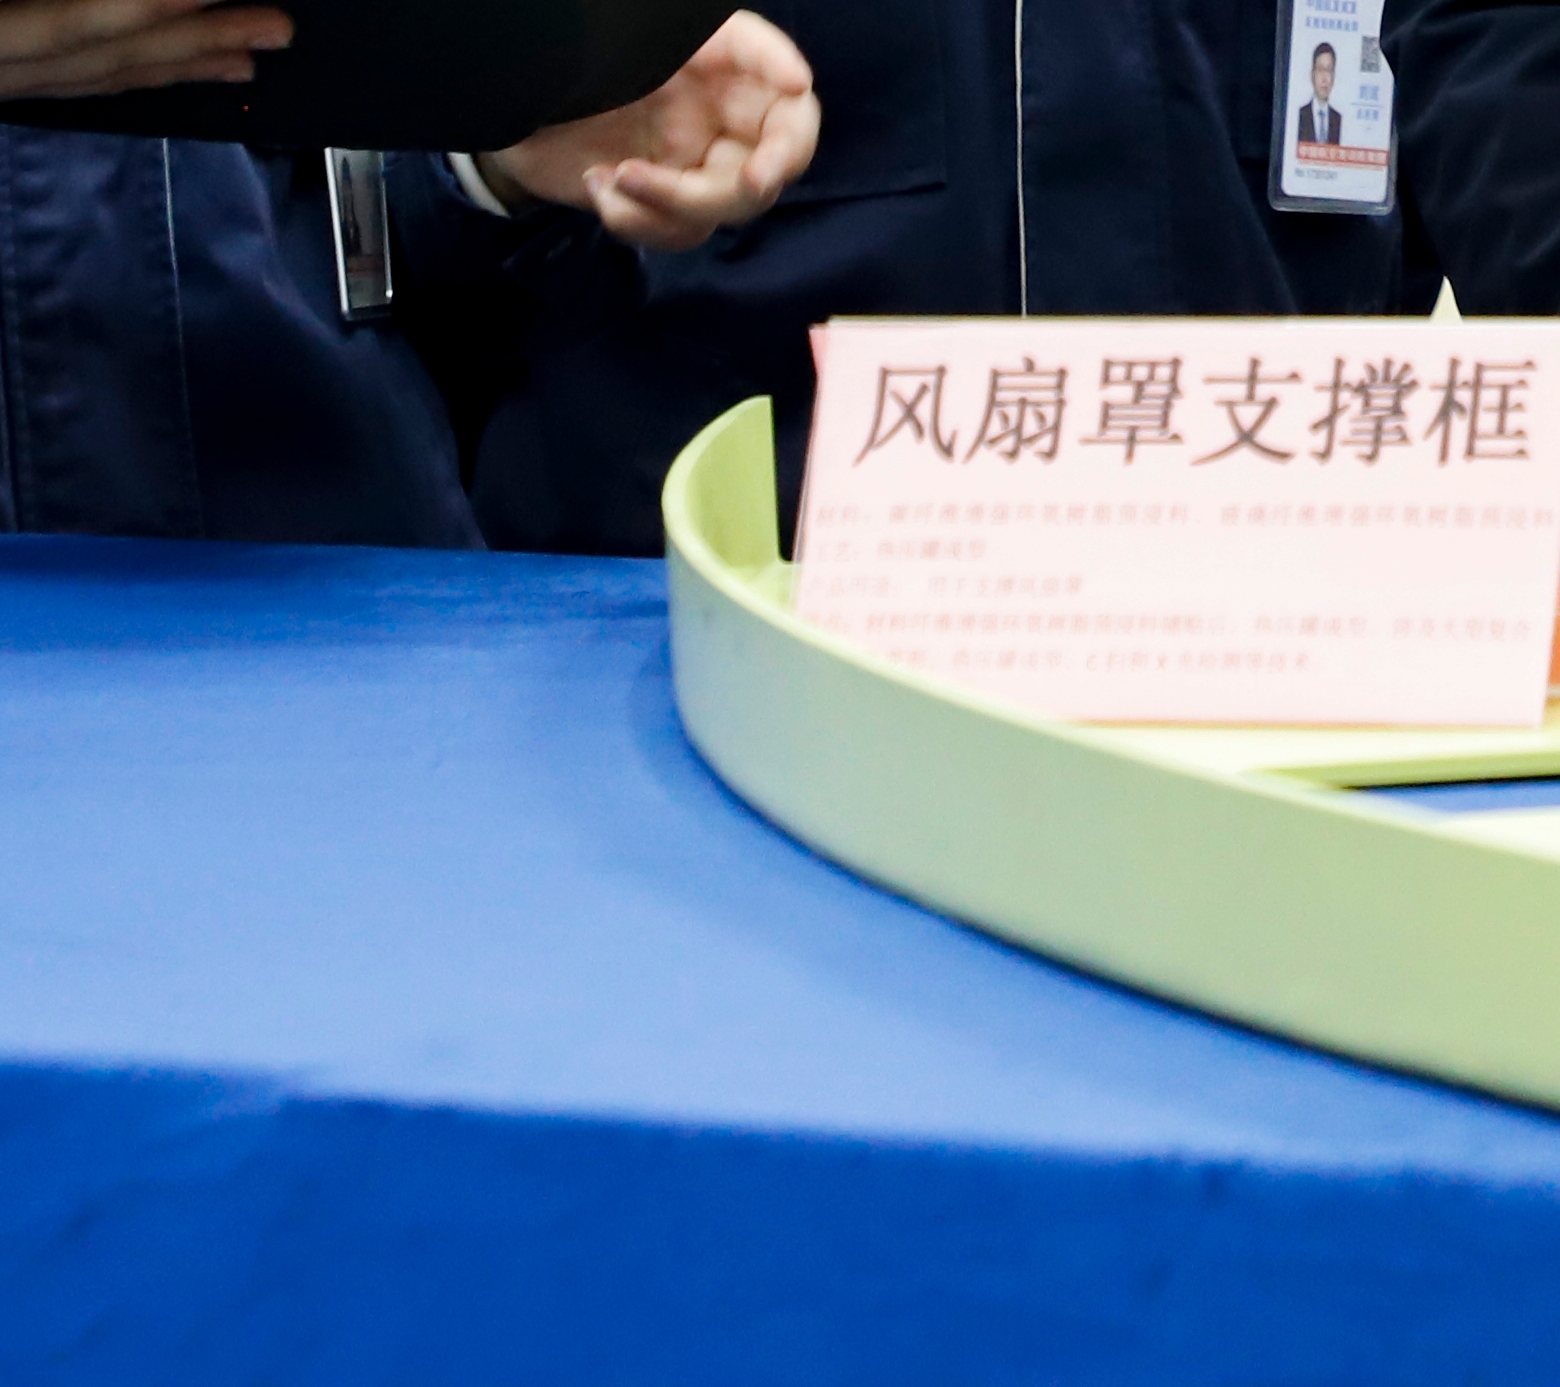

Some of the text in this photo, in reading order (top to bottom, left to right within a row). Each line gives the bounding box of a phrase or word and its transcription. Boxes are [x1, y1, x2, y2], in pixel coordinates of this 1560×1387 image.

[850, 355, 1537, 467] 风扇罩支撑框
